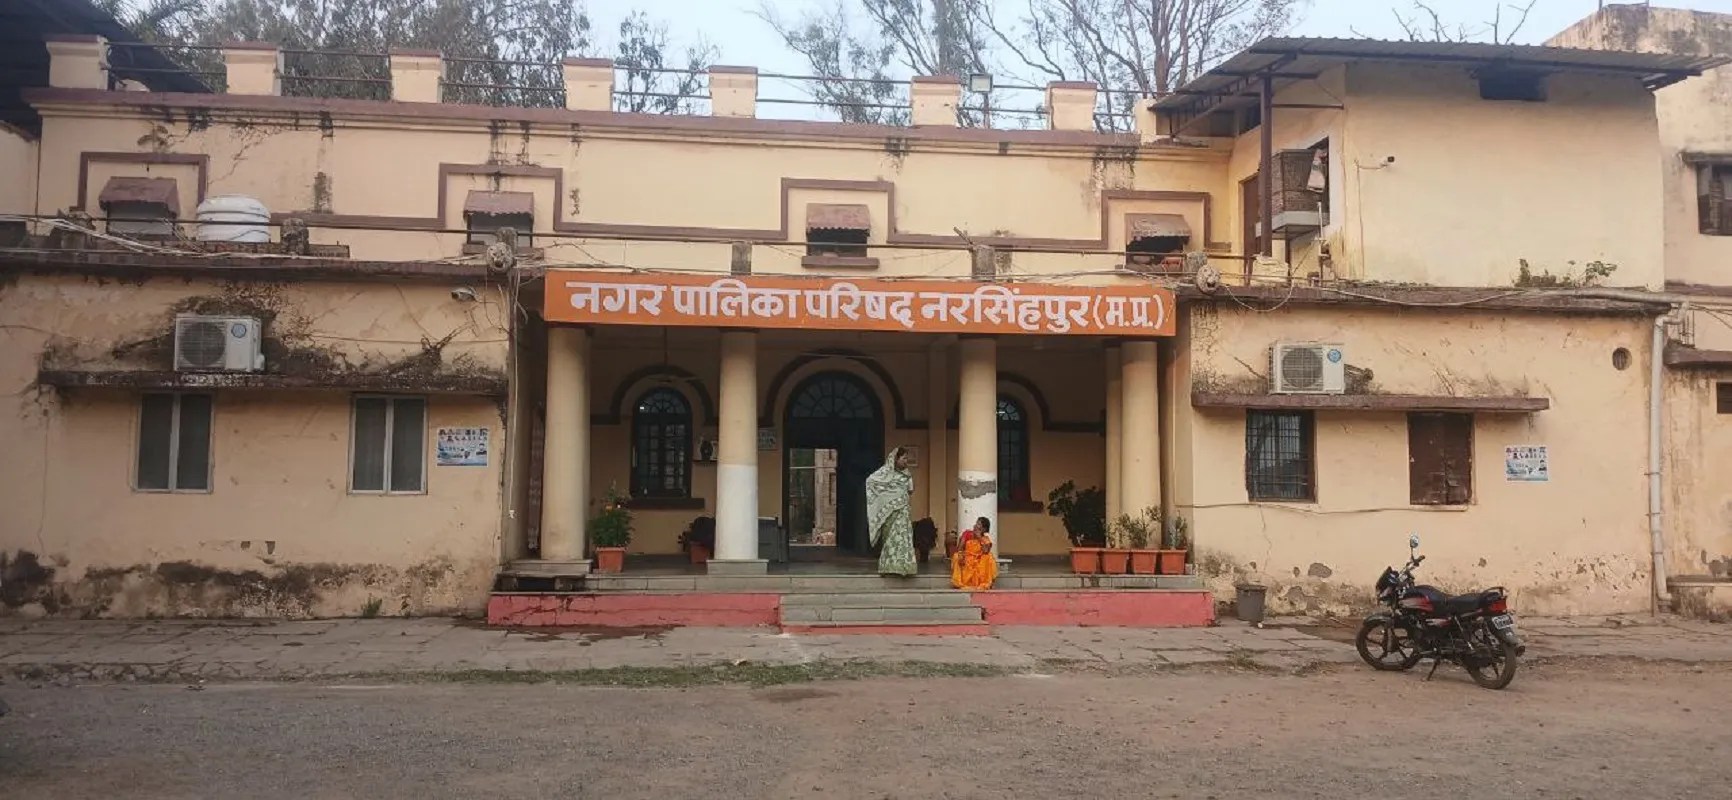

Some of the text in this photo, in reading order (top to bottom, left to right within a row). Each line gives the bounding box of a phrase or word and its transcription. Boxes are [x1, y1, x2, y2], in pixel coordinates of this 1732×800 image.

[566, 282, 667, 316] नगर
[671, 278, 802, 318] पालिका
[804, 282, 916, 328] परिषद
[919, 285, 1091, 333] नरसिंहपुर
